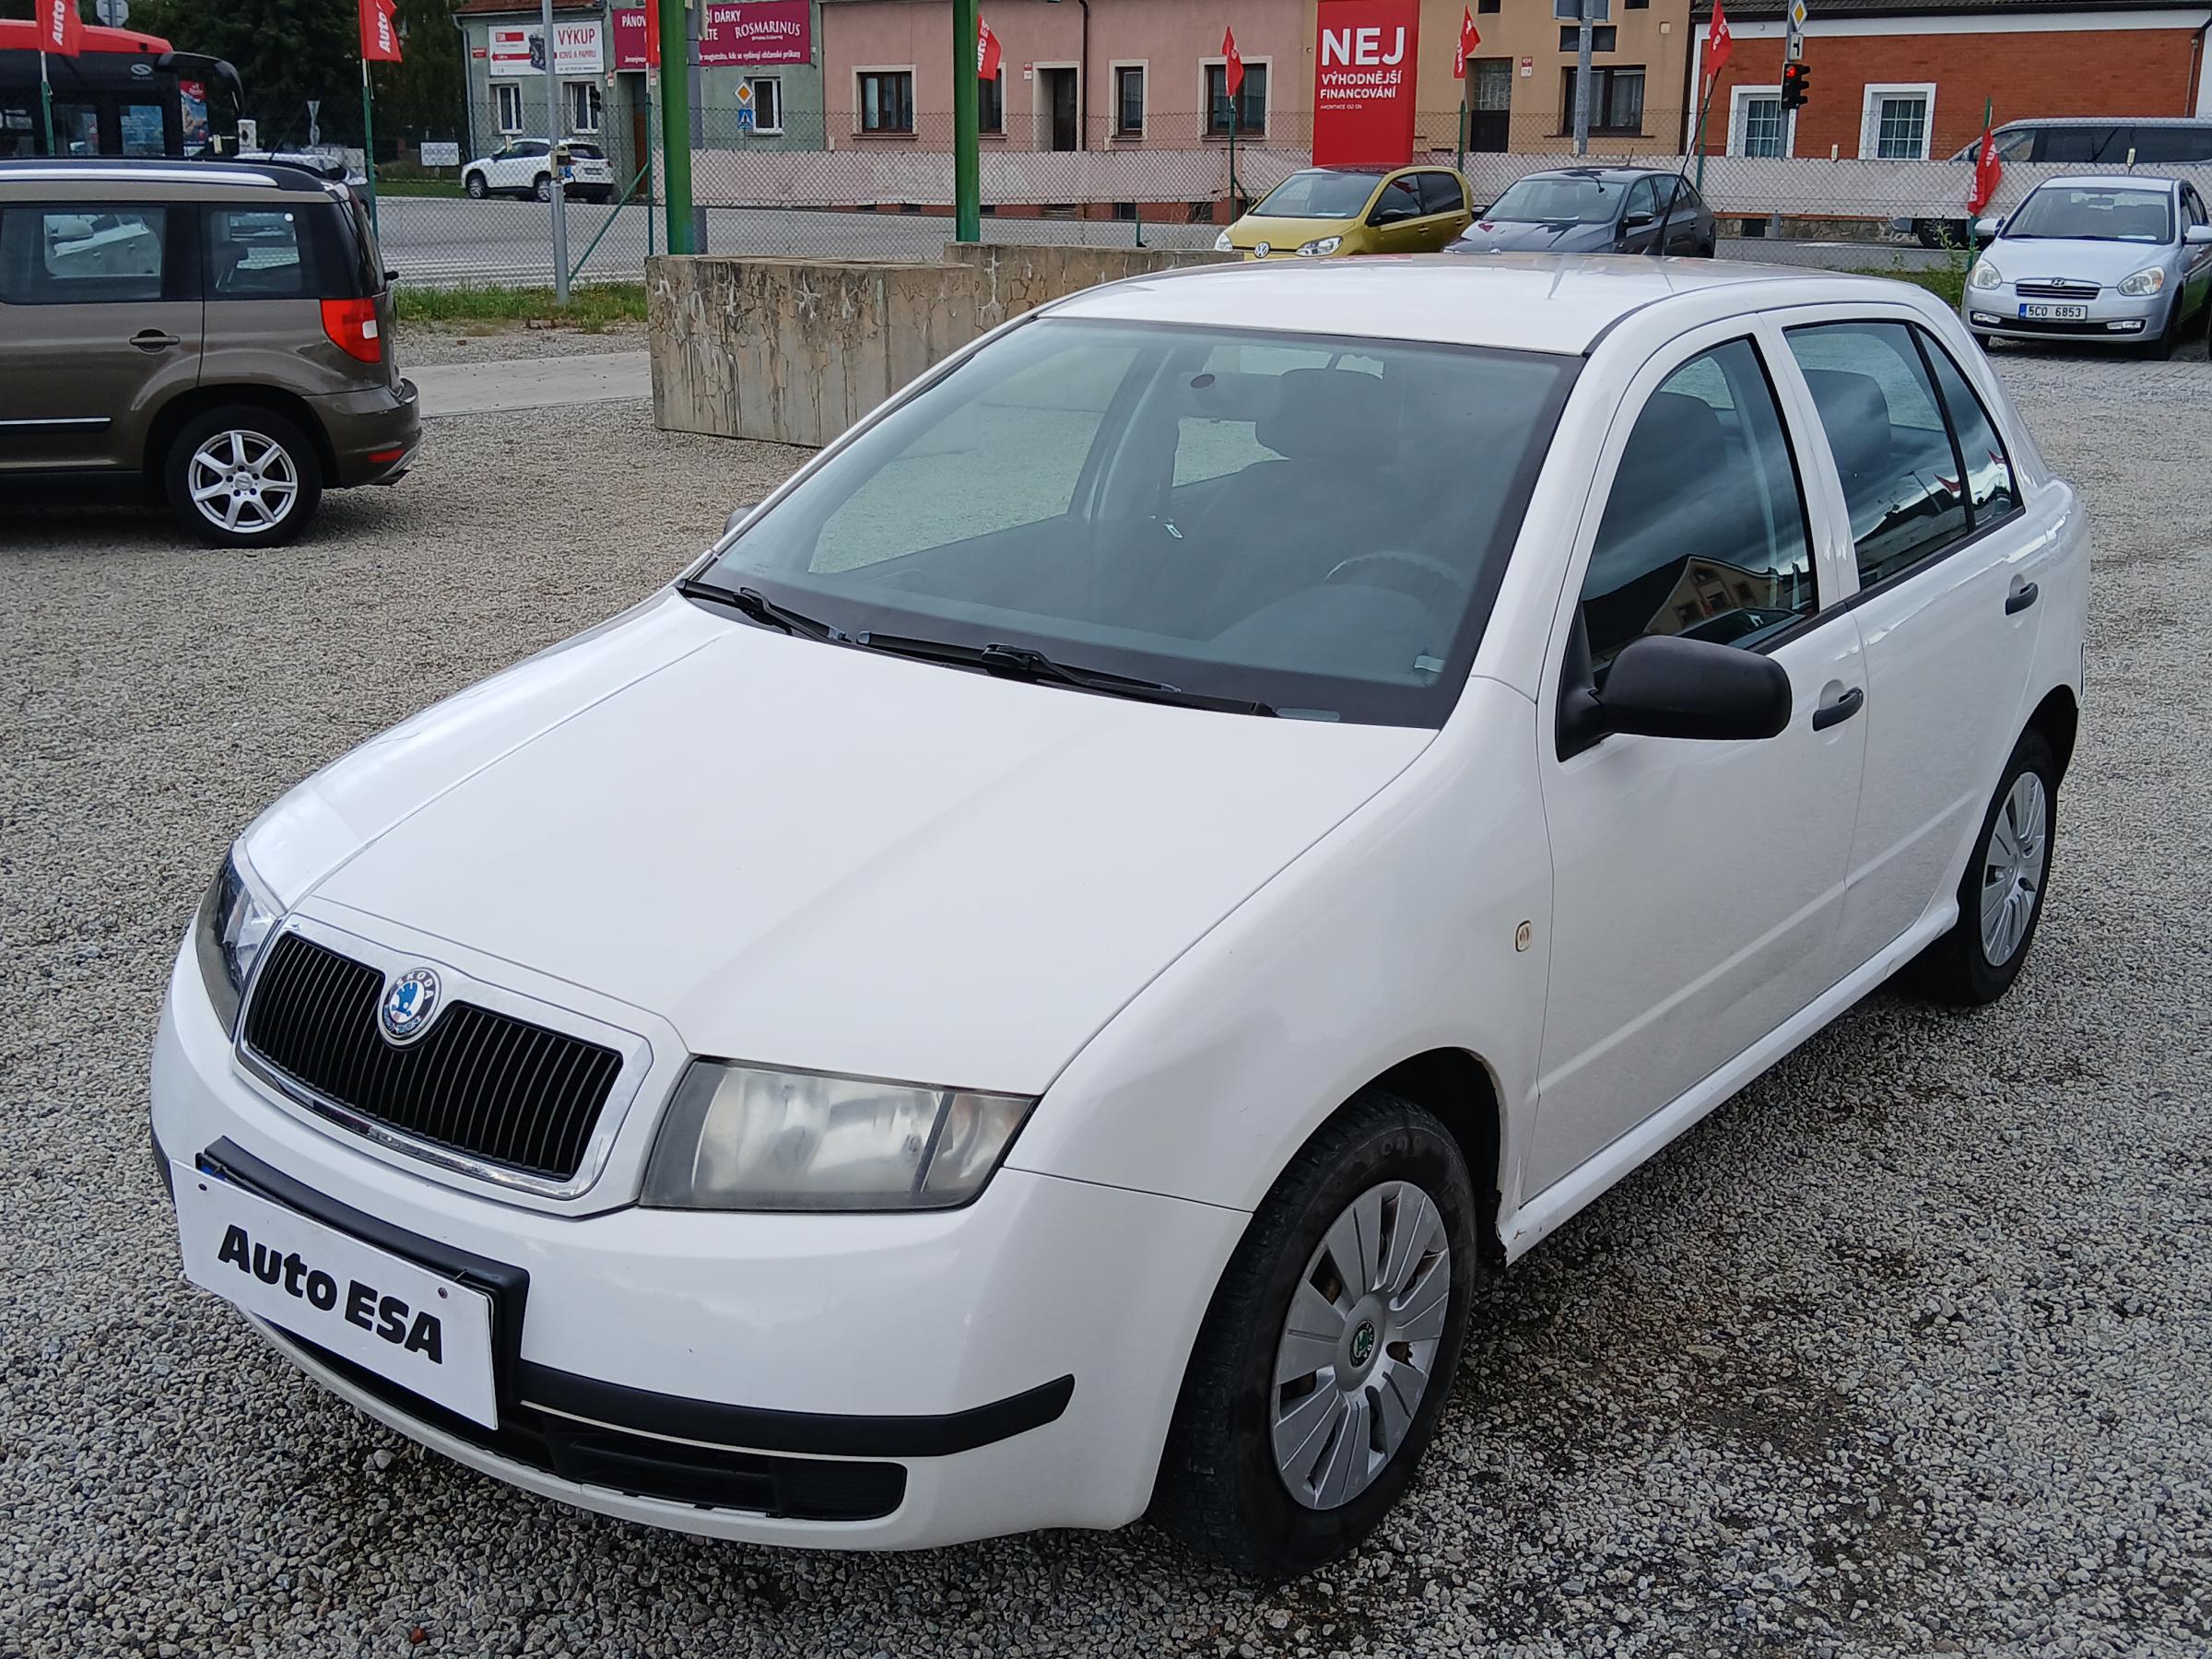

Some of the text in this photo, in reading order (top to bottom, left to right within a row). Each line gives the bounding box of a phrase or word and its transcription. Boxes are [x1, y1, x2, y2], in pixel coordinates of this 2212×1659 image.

[714, 8, 741, 23] DÁRKY
[558, 27, 595, 45] VÝKUP
[735, 20, 801, 39] ROSMARINUS
[1321, 27, 1406, 66] NEJ
[1321, 70, 1403, 86] VÝHODNĚJŠÍ
[1320, 86, 1396, 100] FINANCOVÁNÍ
[2054, 307, 2081, 318] 6853
[218, 1224, 443, 1365] Auto ESA
